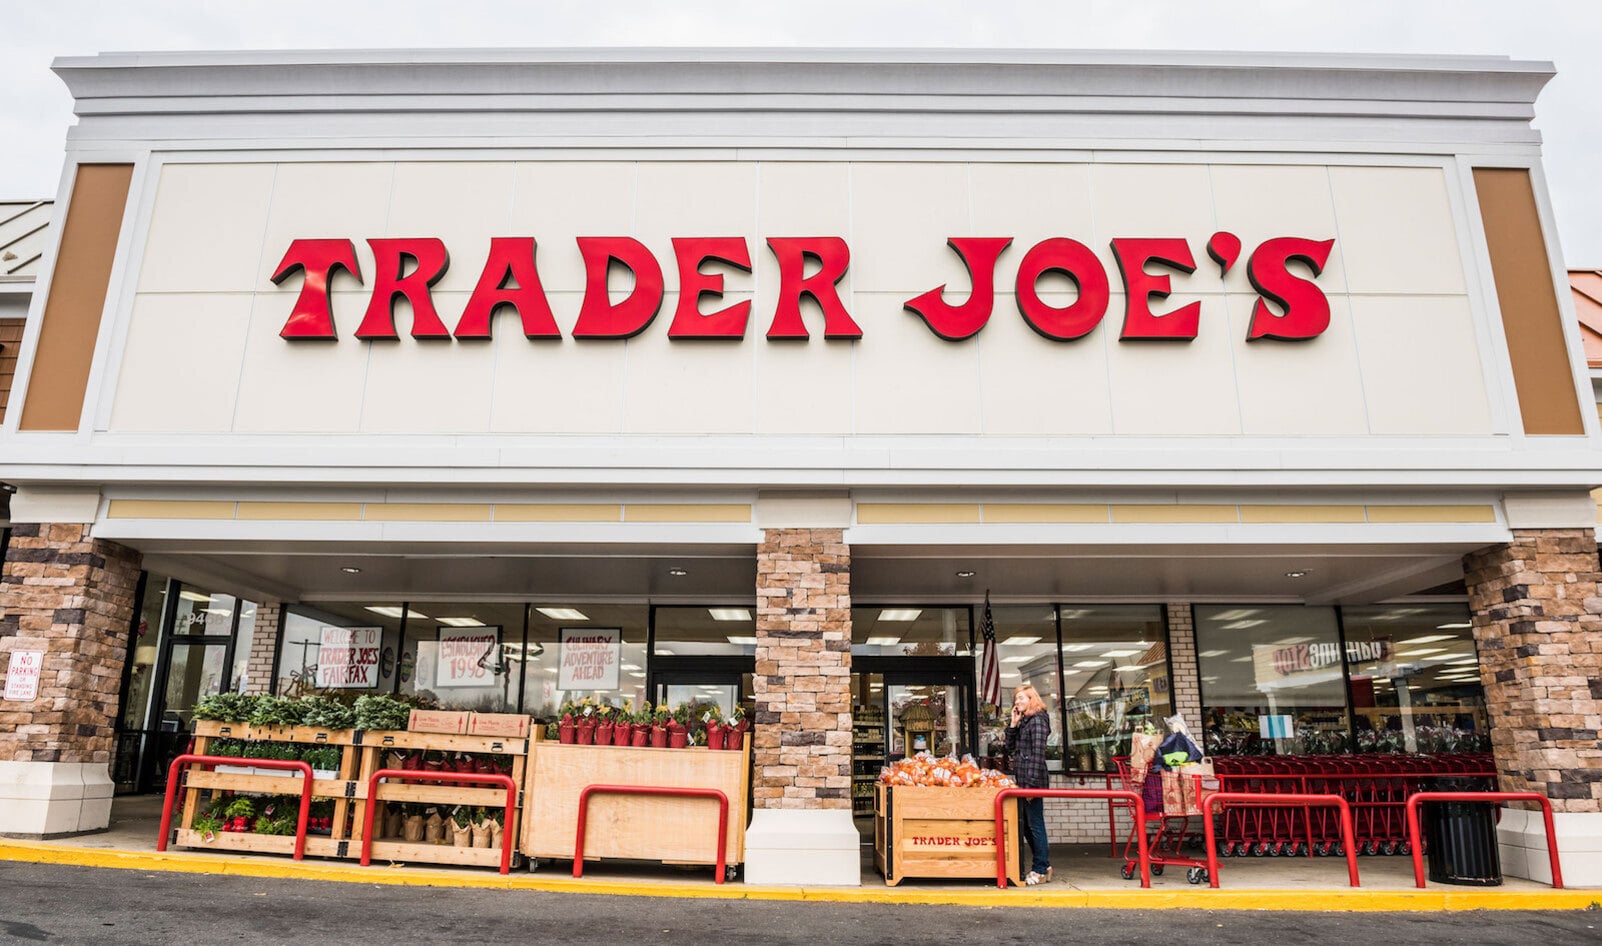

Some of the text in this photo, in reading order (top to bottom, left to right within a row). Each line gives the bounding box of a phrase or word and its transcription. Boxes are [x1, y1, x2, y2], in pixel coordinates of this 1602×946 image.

[271, 231, 1335, 341] TRADER JOE'S
[323, 629, 376, 644] WELCOME TO
[565, 635, 612, 651] CULINARY
[20, 656, 33, 665] NO
[320, 647, 356, 665] TRADER
[563, 651, 613, 667] ADVENTURE
[11, 667, 38, 676] PARKING
[322, 665, 369, 685] FAIRFAX
[571, 666, 604, 681] AHEAD
[912, 836, 960, 845] TRADER
